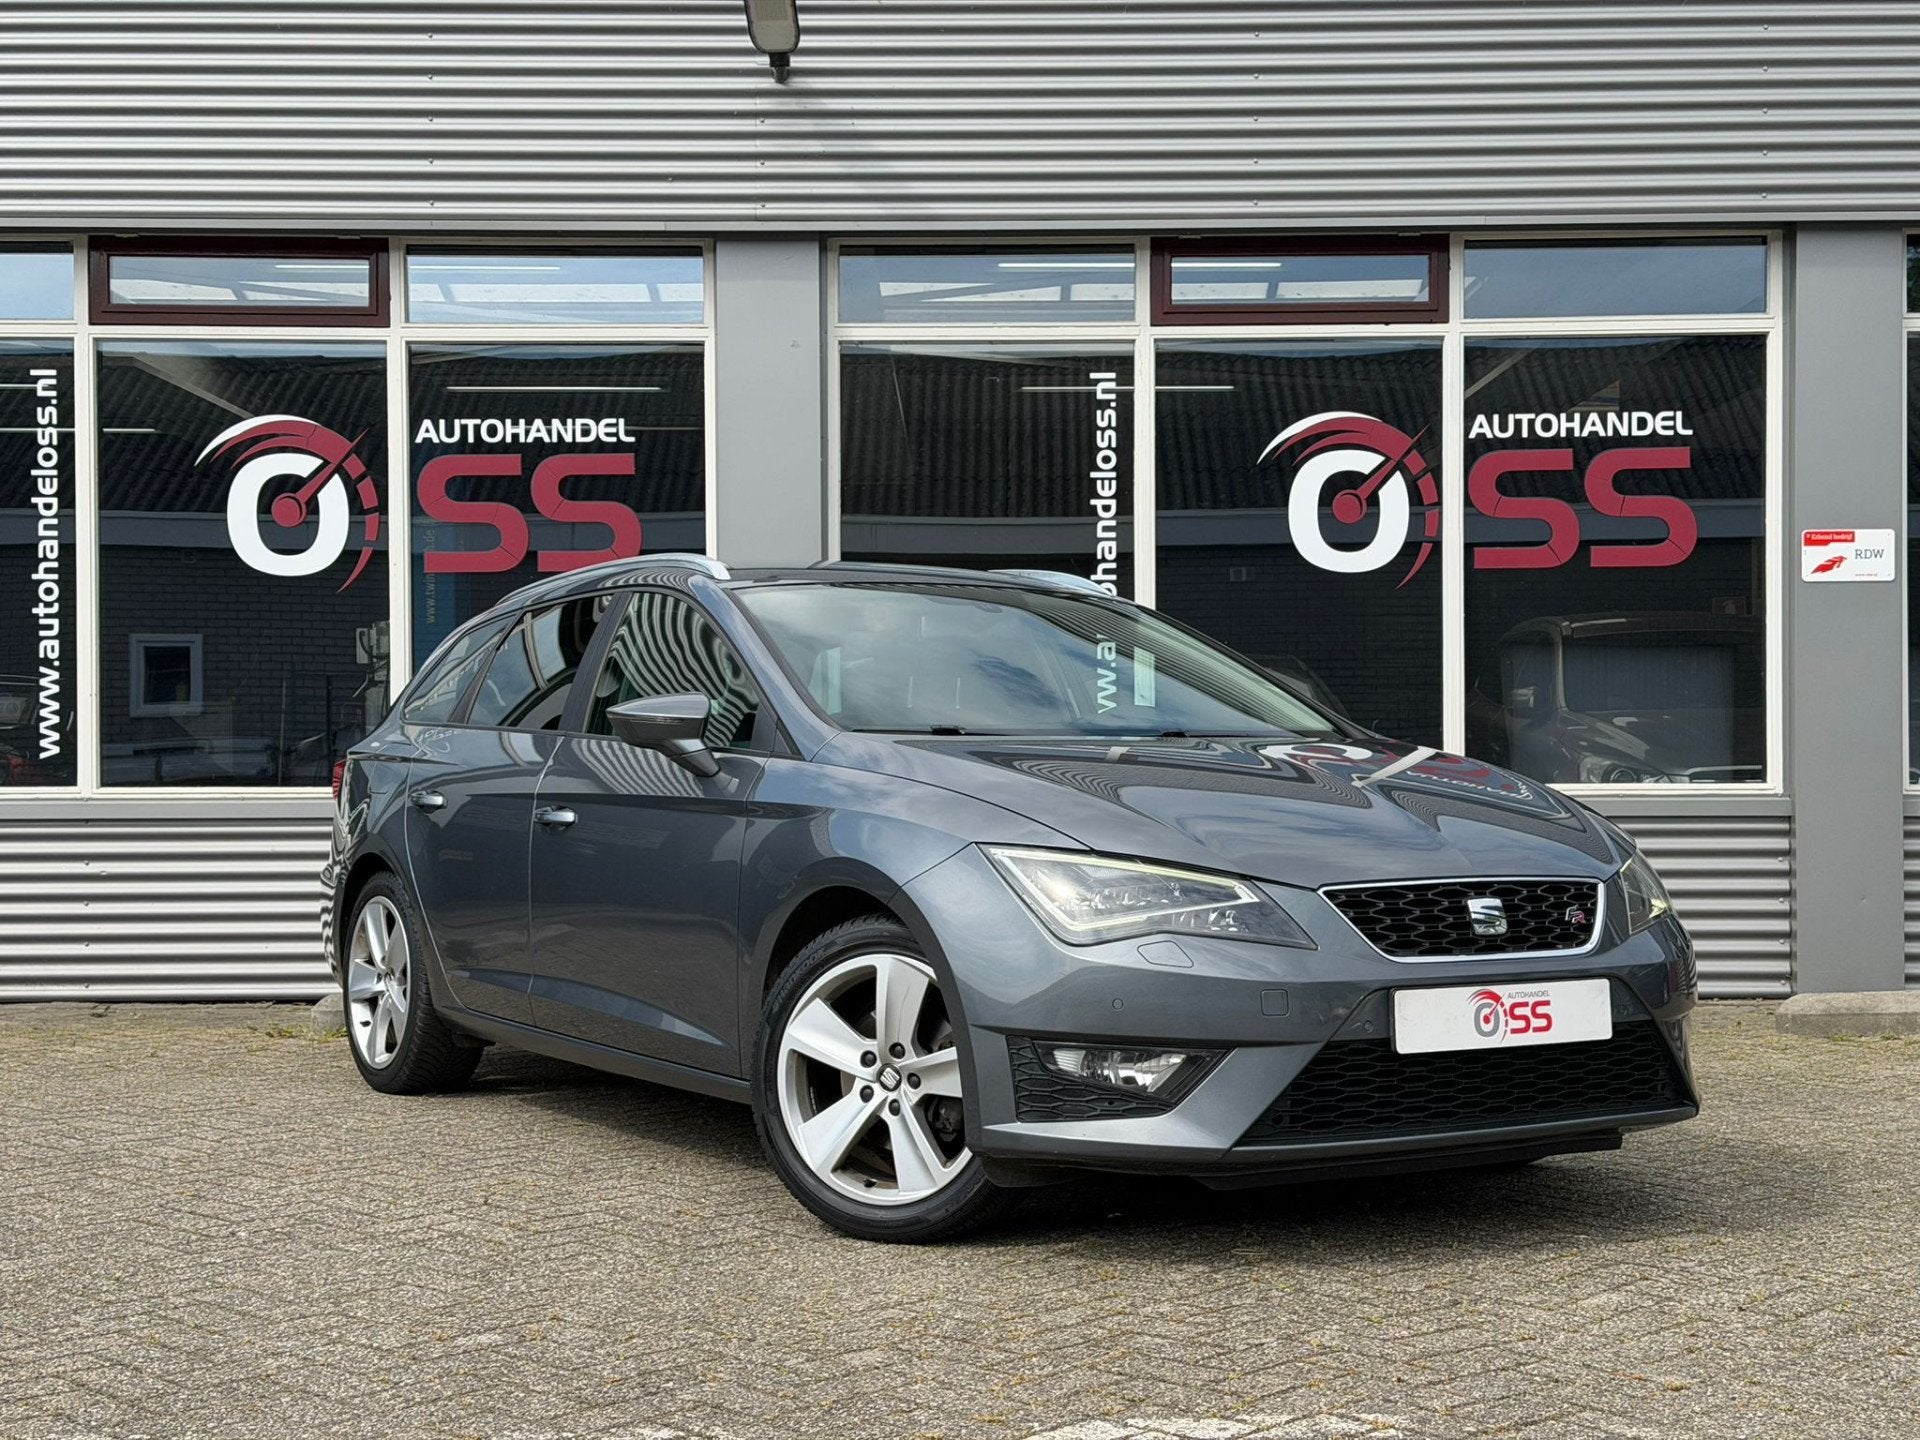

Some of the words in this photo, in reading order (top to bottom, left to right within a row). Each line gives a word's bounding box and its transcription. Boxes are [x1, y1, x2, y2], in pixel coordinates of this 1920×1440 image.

[414, 417, 637, 444] AUTOHANDEL
[1468, 410, 1695, 440] AUTOHANDEL
[29, 369, 60, 759] www.autohandeloss.nl
[1854, 549, 1885, 560] RDW
[1507, 990, 1550, 999] AUTOHANDEL
